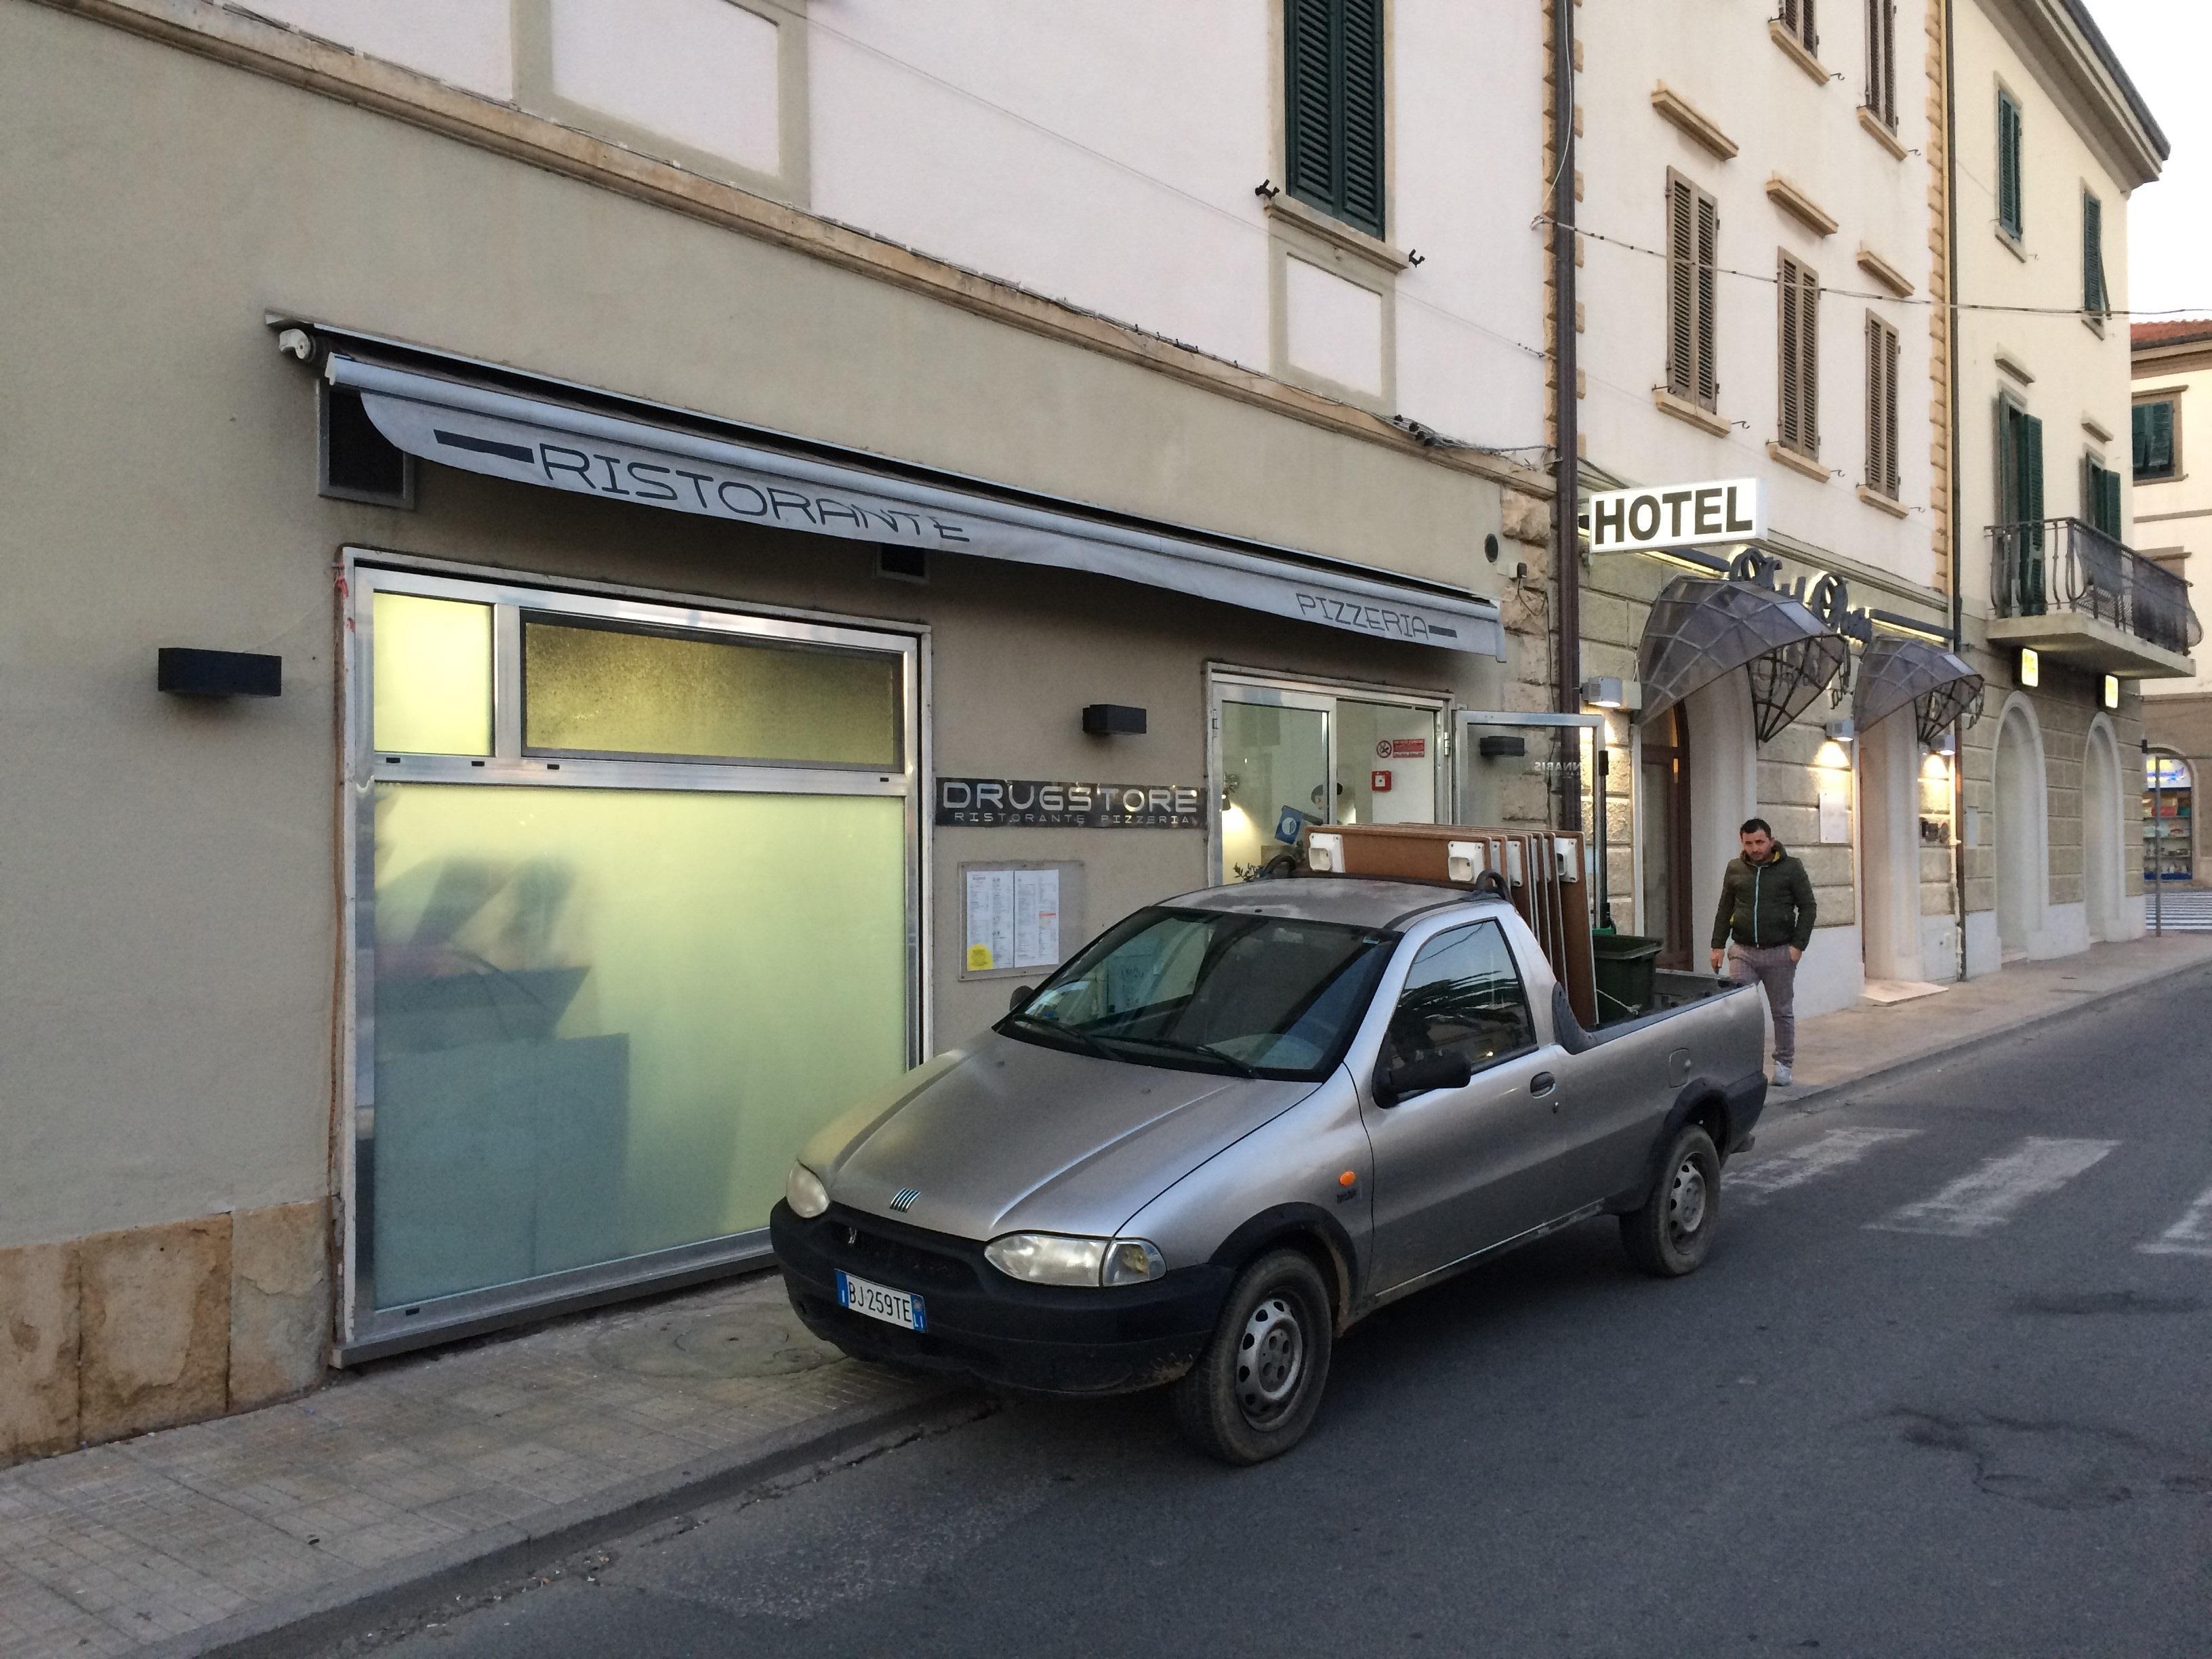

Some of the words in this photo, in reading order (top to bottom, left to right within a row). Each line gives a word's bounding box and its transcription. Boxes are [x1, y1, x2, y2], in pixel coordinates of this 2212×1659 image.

[541, 443, 970, 542] RISTORANTE
[1595, 486, 1754, 545] HOTEL
[1295, 592, 1429, 640] PIZZERIA
[942, 781, 1197, 813] DRUGSTORE
[954, 812, 1085, 824] RISTORANTE
[1101, 815, 1189, 824] PIZZERIA
